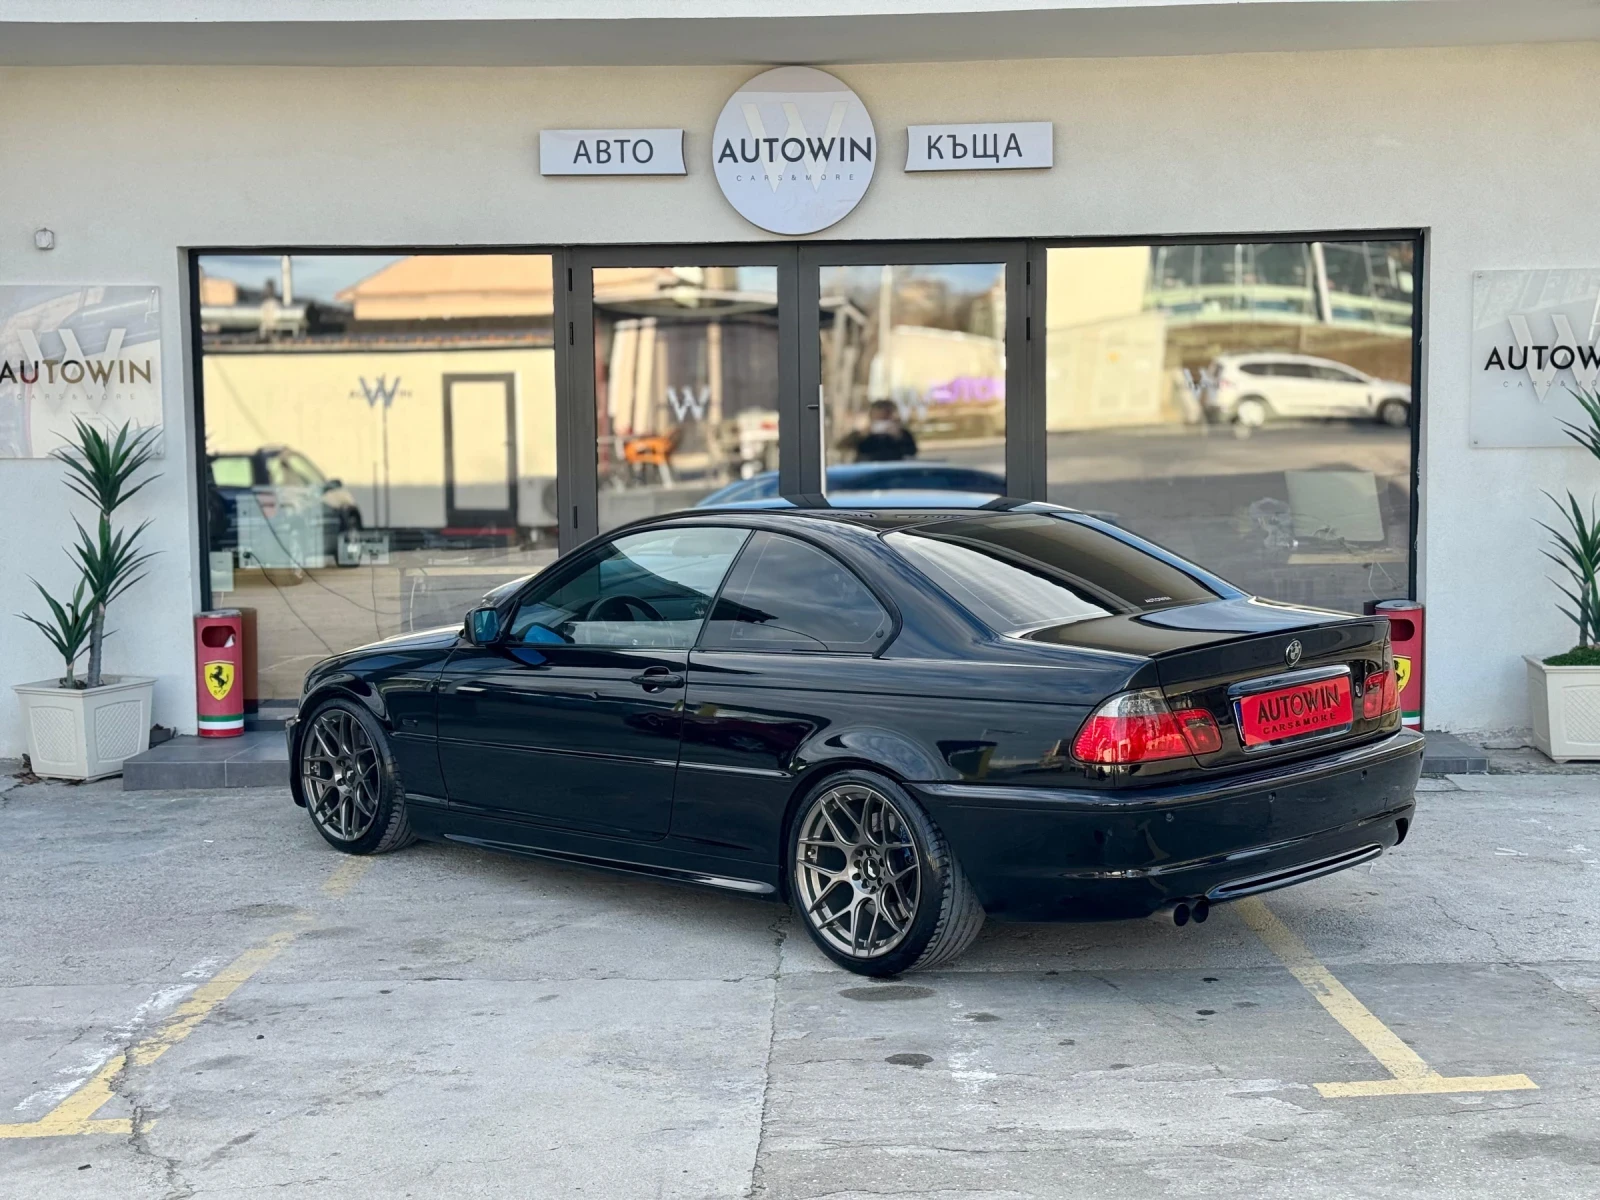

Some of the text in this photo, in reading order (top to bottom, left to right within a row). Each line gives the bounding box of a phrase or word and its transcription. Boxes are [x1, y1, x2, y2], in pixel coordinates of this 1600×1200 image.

[573, 138, 654, 164] АВТО
[717, 137, 872, 163] AUTOWIN
[927, 132, 1023, 164] КЪЩА
[0, 359, 152, 384] AUTOWIN
[1257, 683, 1341, 725] AUTOWIN
[1263, 712, 1337, 735] CARS&MORE
